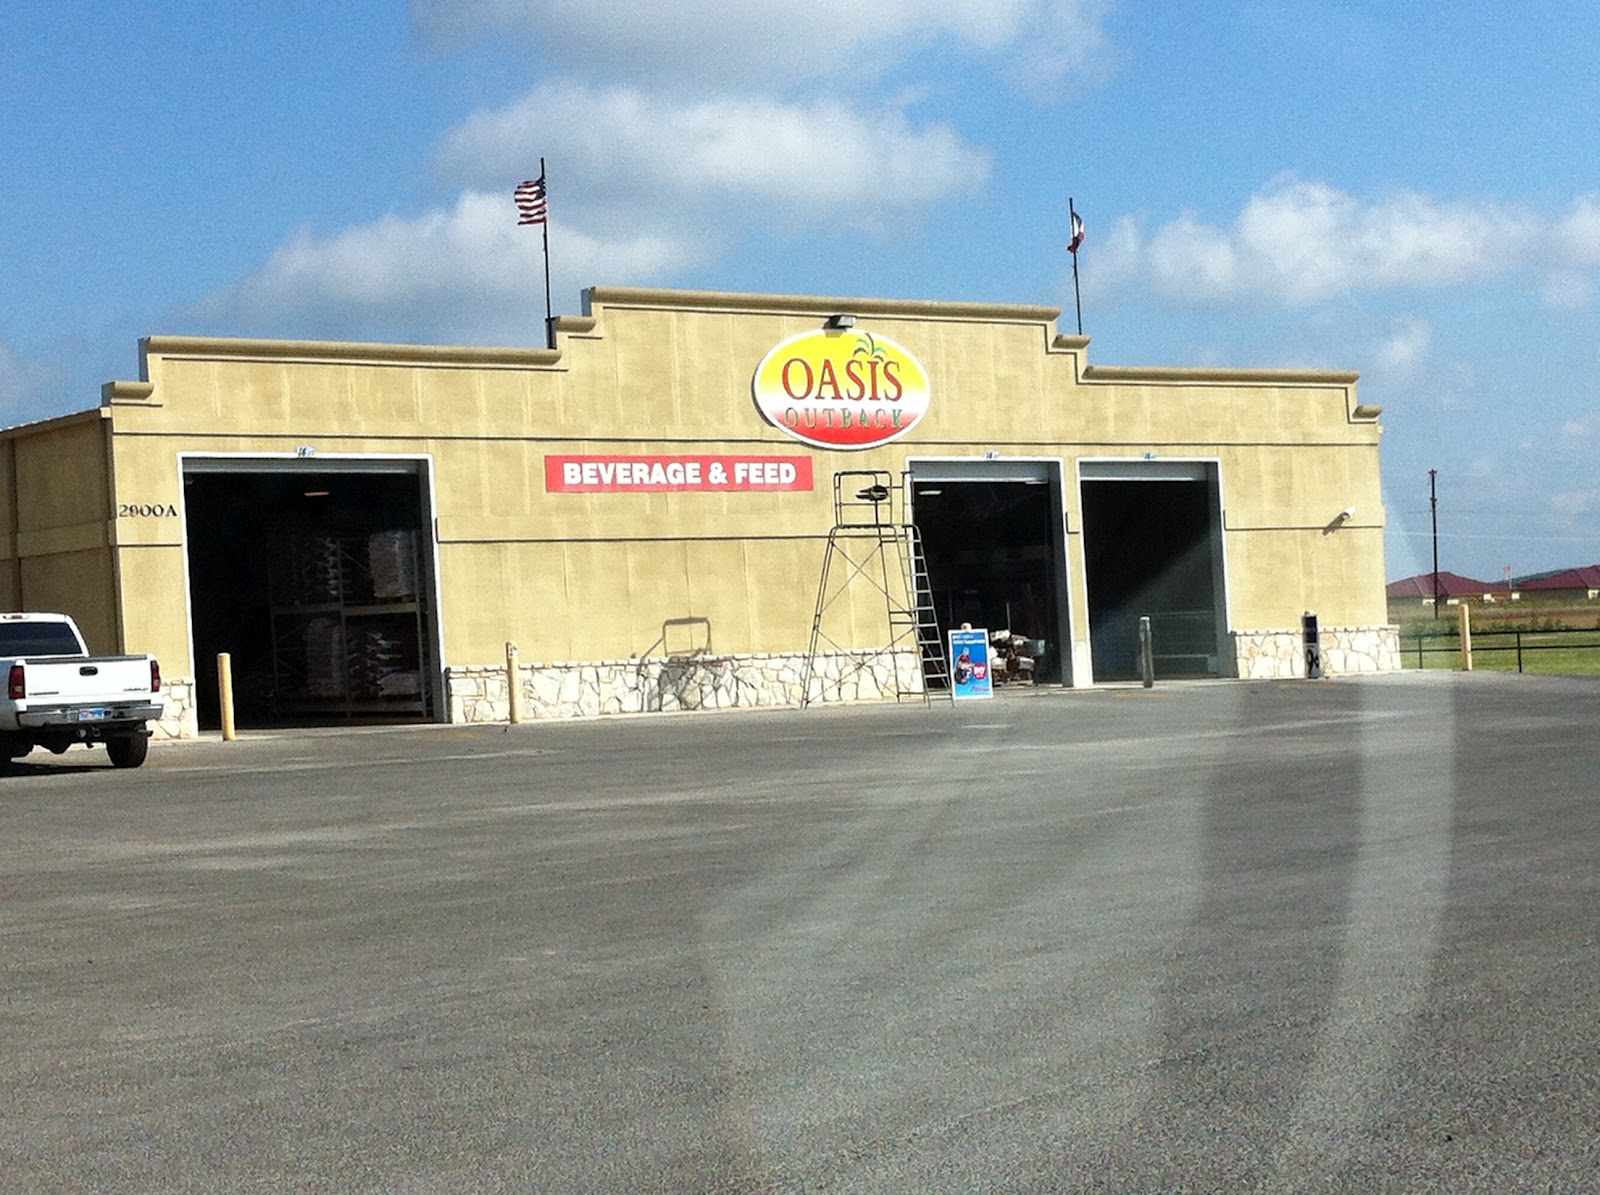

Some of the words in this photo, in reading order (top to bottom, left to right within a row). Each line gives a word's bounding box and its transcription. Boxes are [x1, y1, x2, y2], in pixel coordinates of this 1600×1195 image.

[782, 358, 903, 402] OASIS
[785, 407, 904, 429] OUTBACK
[563, 462, 702, 485] BEVERAGE
[708, 462, 729, 485] &
[734, 462, 797, 485] FEED
